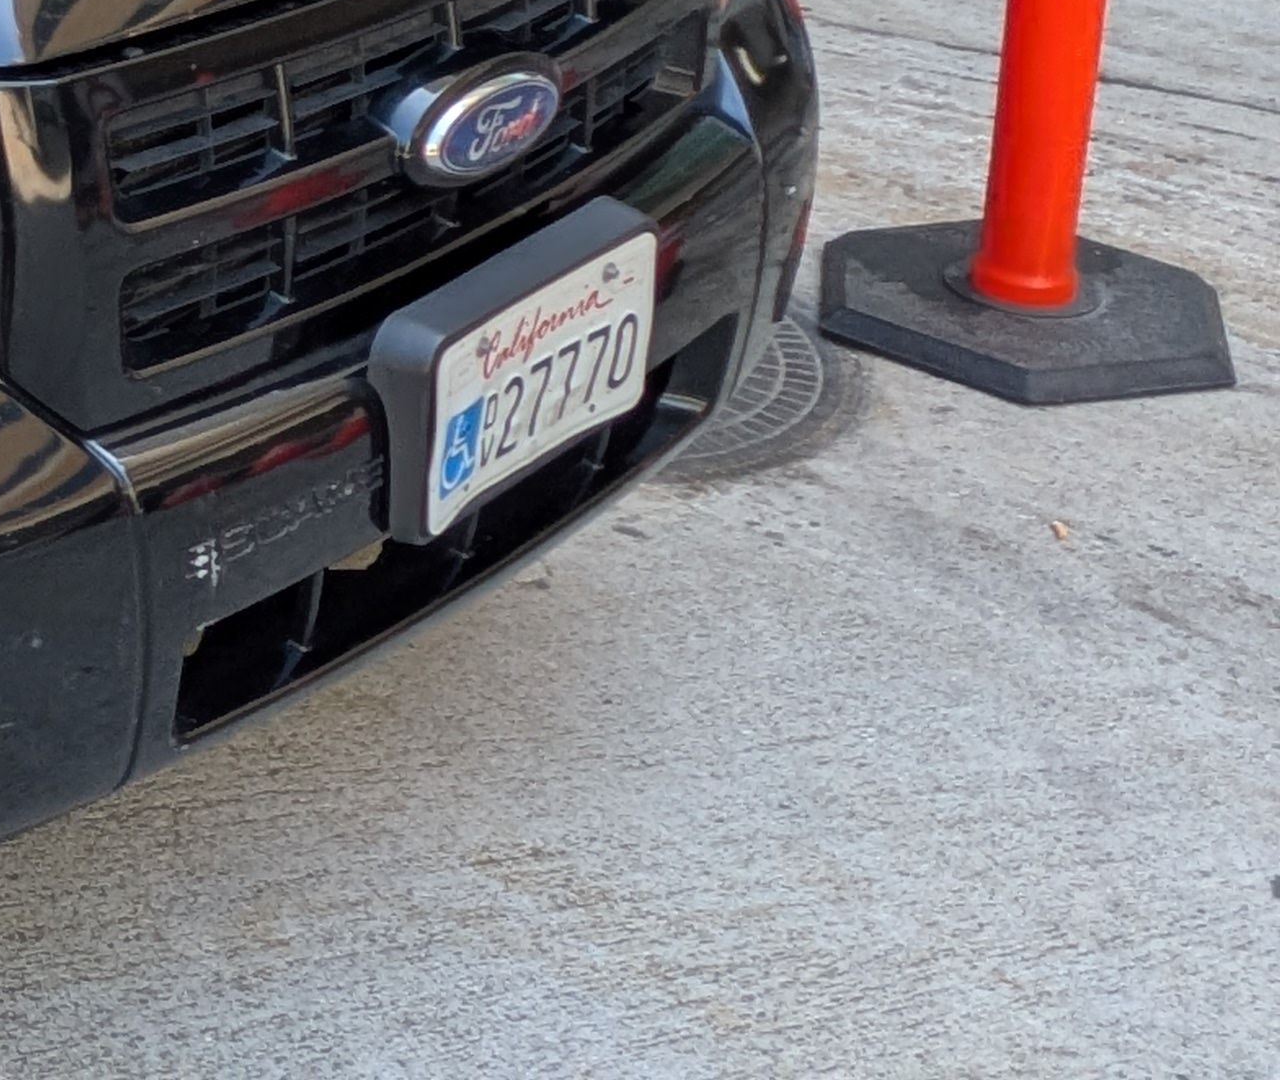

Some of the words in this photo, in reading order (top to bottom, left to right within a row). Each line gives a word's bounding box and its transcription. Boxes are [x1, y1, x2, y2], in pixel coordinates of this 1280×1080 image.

[467, 95, 541, 162] Ford
[481, 284, 613, 380] California
[495, 312, 639, 458] 27770
